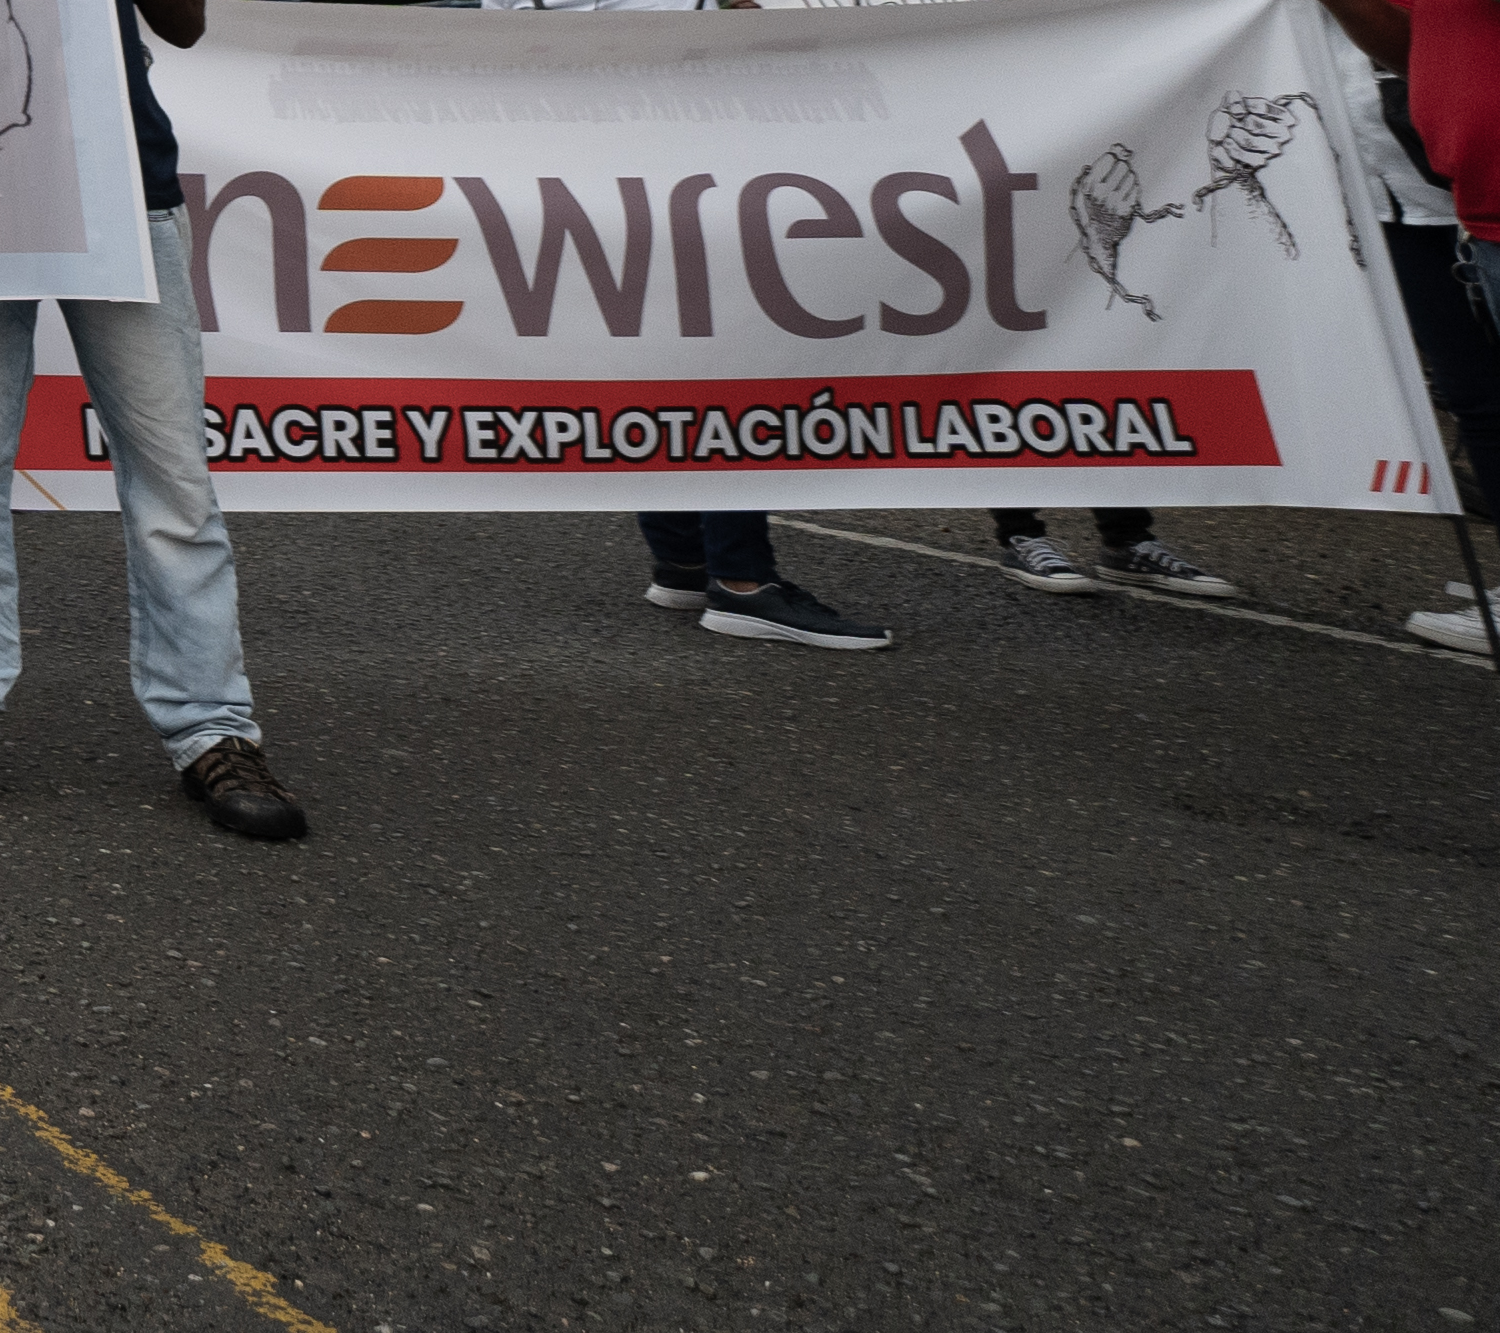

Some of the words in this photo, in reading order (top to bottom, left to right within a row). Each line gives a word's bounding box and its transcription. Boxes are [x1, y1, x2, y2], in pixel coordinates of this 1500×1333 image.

[85, 407, 394, 458] SACRE
[408, 410, 450, 457] Y
[464, 392, 893, 460] EXPLOTACIÓN
[904, 401, 1192, 454] LABORAL
